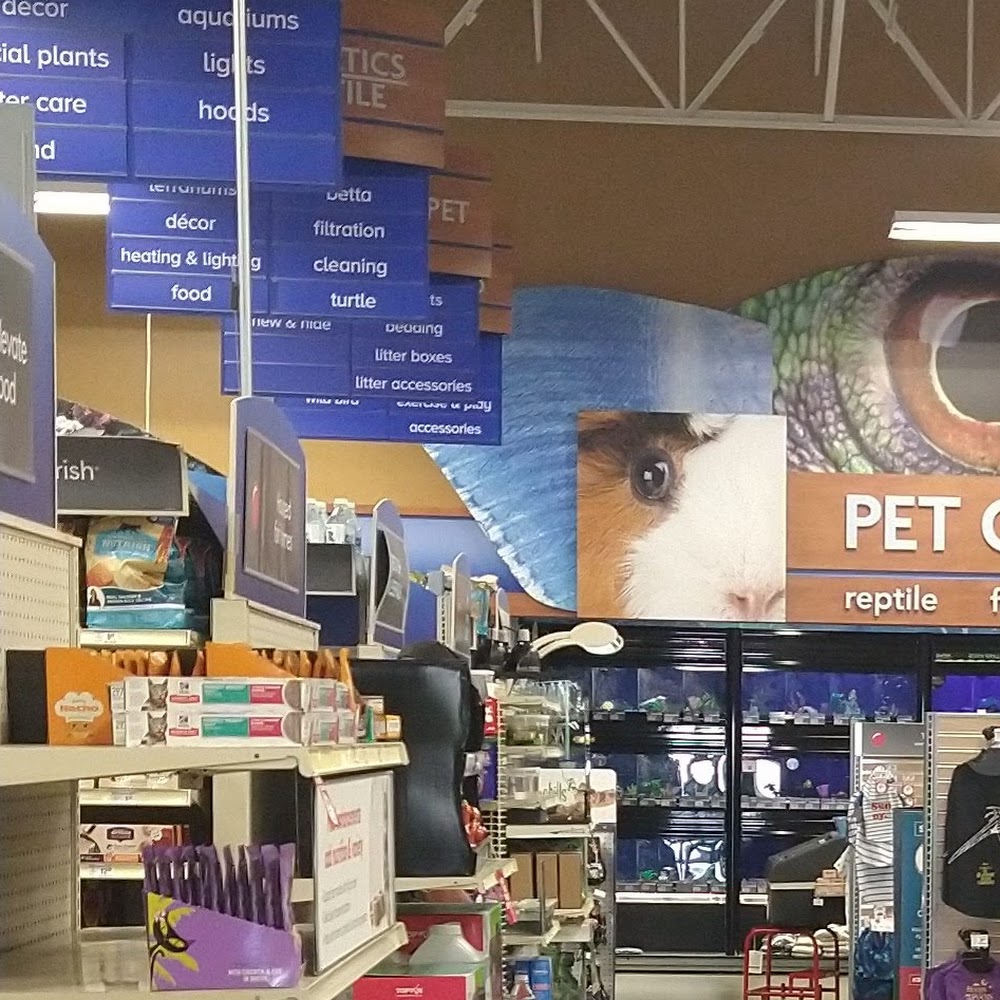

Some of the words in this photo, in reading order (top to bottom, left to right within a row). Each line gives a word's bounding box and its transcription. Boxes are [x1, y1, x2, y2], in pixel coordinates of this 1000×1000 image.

[178, 7, 300, 30] aquaiums
[0, 43, 30, 64] ial
[38, 45, 110, 69] plants
[36, 95, 87, 114] care
[199, 100, 270, 123] hoods
[428, 197, 471, 224] PET
[165, 213, 216, 231] décor
[313, 220, 385, 239] filtration
[120, 247, 181, 267] heating
[185, 251, 198, 265] &
[203, 250, 261, 271] lightig
[313, 257, 388, 277] cleaning
[171, 284, 212, 301] food
[330, 292, 377, 309] turtle
[375, 348, 407, 362] litter
[411, 349, 452, 364] boxes
[356, 375, 387, 390] litter
[391, 378, 472, 393] accessories
[409, 423, 482, 435] accessories
[845, 494, 962, 552] PET
[845, 586, 938, 617] reptile
